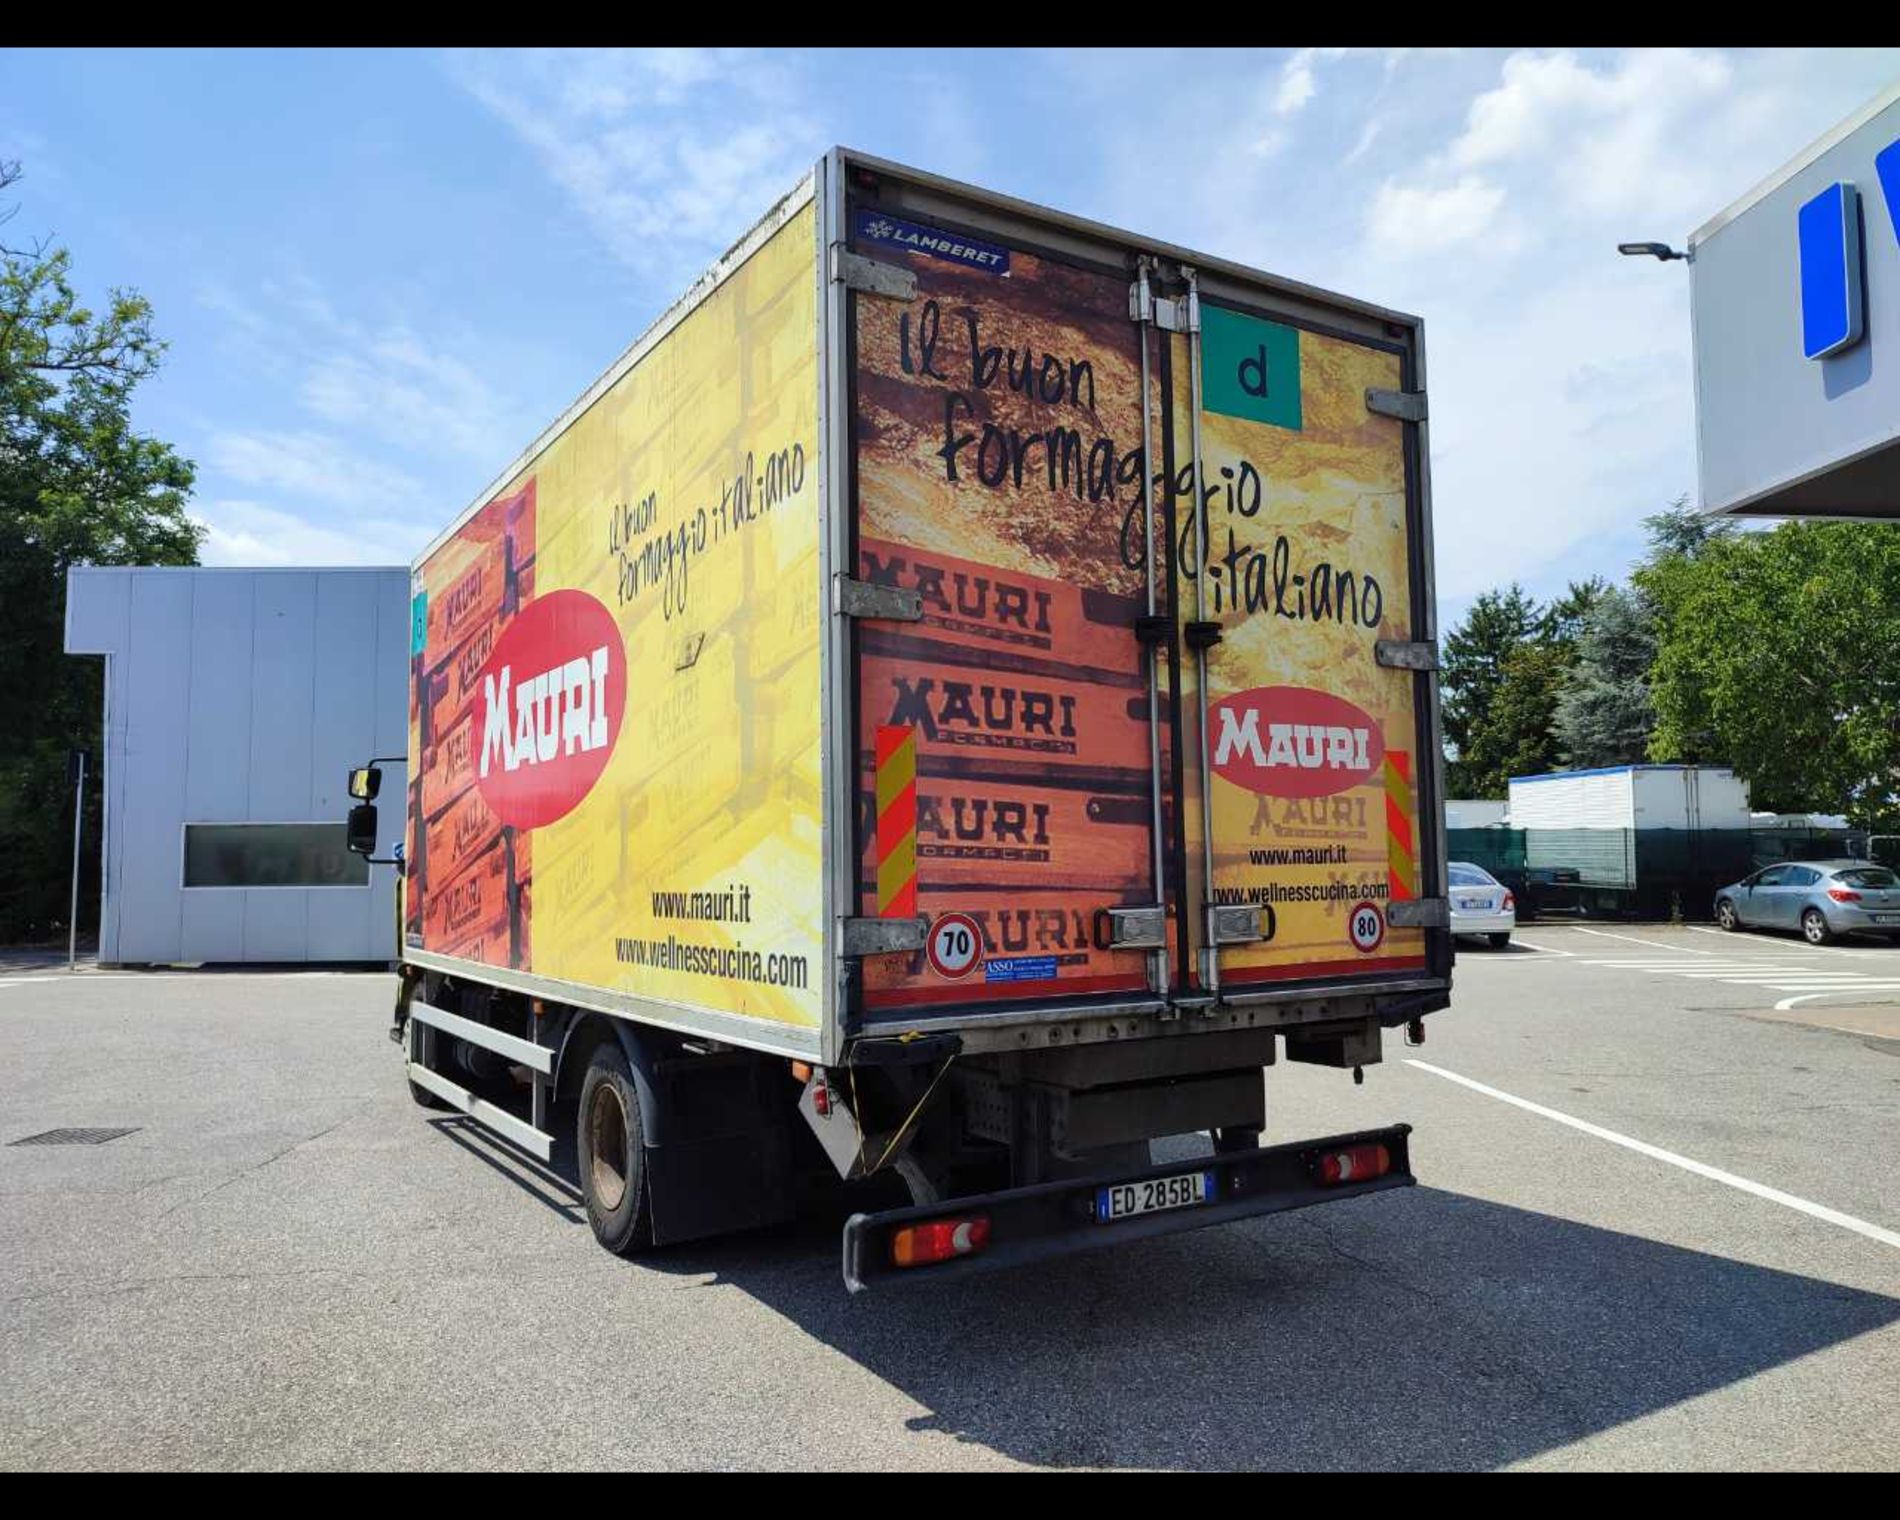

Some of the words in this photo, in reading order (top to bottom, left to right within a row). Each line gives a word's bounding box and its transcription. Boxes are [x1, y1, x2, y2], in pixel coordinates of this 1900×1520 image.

[893, 229, 1003, 266] LAMBERET
[957, 306, 1095, 410] buon
[1238, 343, 1269, 399] d
[936, 391, 1261, 580] formaggio
[617, 507, 706, 621] formaggio
[712, 442, 804, 544] italiano
[624, 489, 657, 545] buon
[1209, 526, 1382, 628] italiano
[478, 644, 609, 779] MAURI
[889, 677, 1076, 742] MAURI
[1214, 707, 1370, 771] MAURI
[916, 795, 1049, 845] AURI
[1250, 844, 1347, 866] www.mauri.it
[652, 884, 751, 923] www.mauri.it
[1357, 917, 1377, 938] 80
[615, 935, 809, 989] www.wellnesscucina.com
[943, 930, 970, 957] 70
[1112, 1186, 1136, 1215] ED
[1143, 1175, 1204, 1210] 285BL
